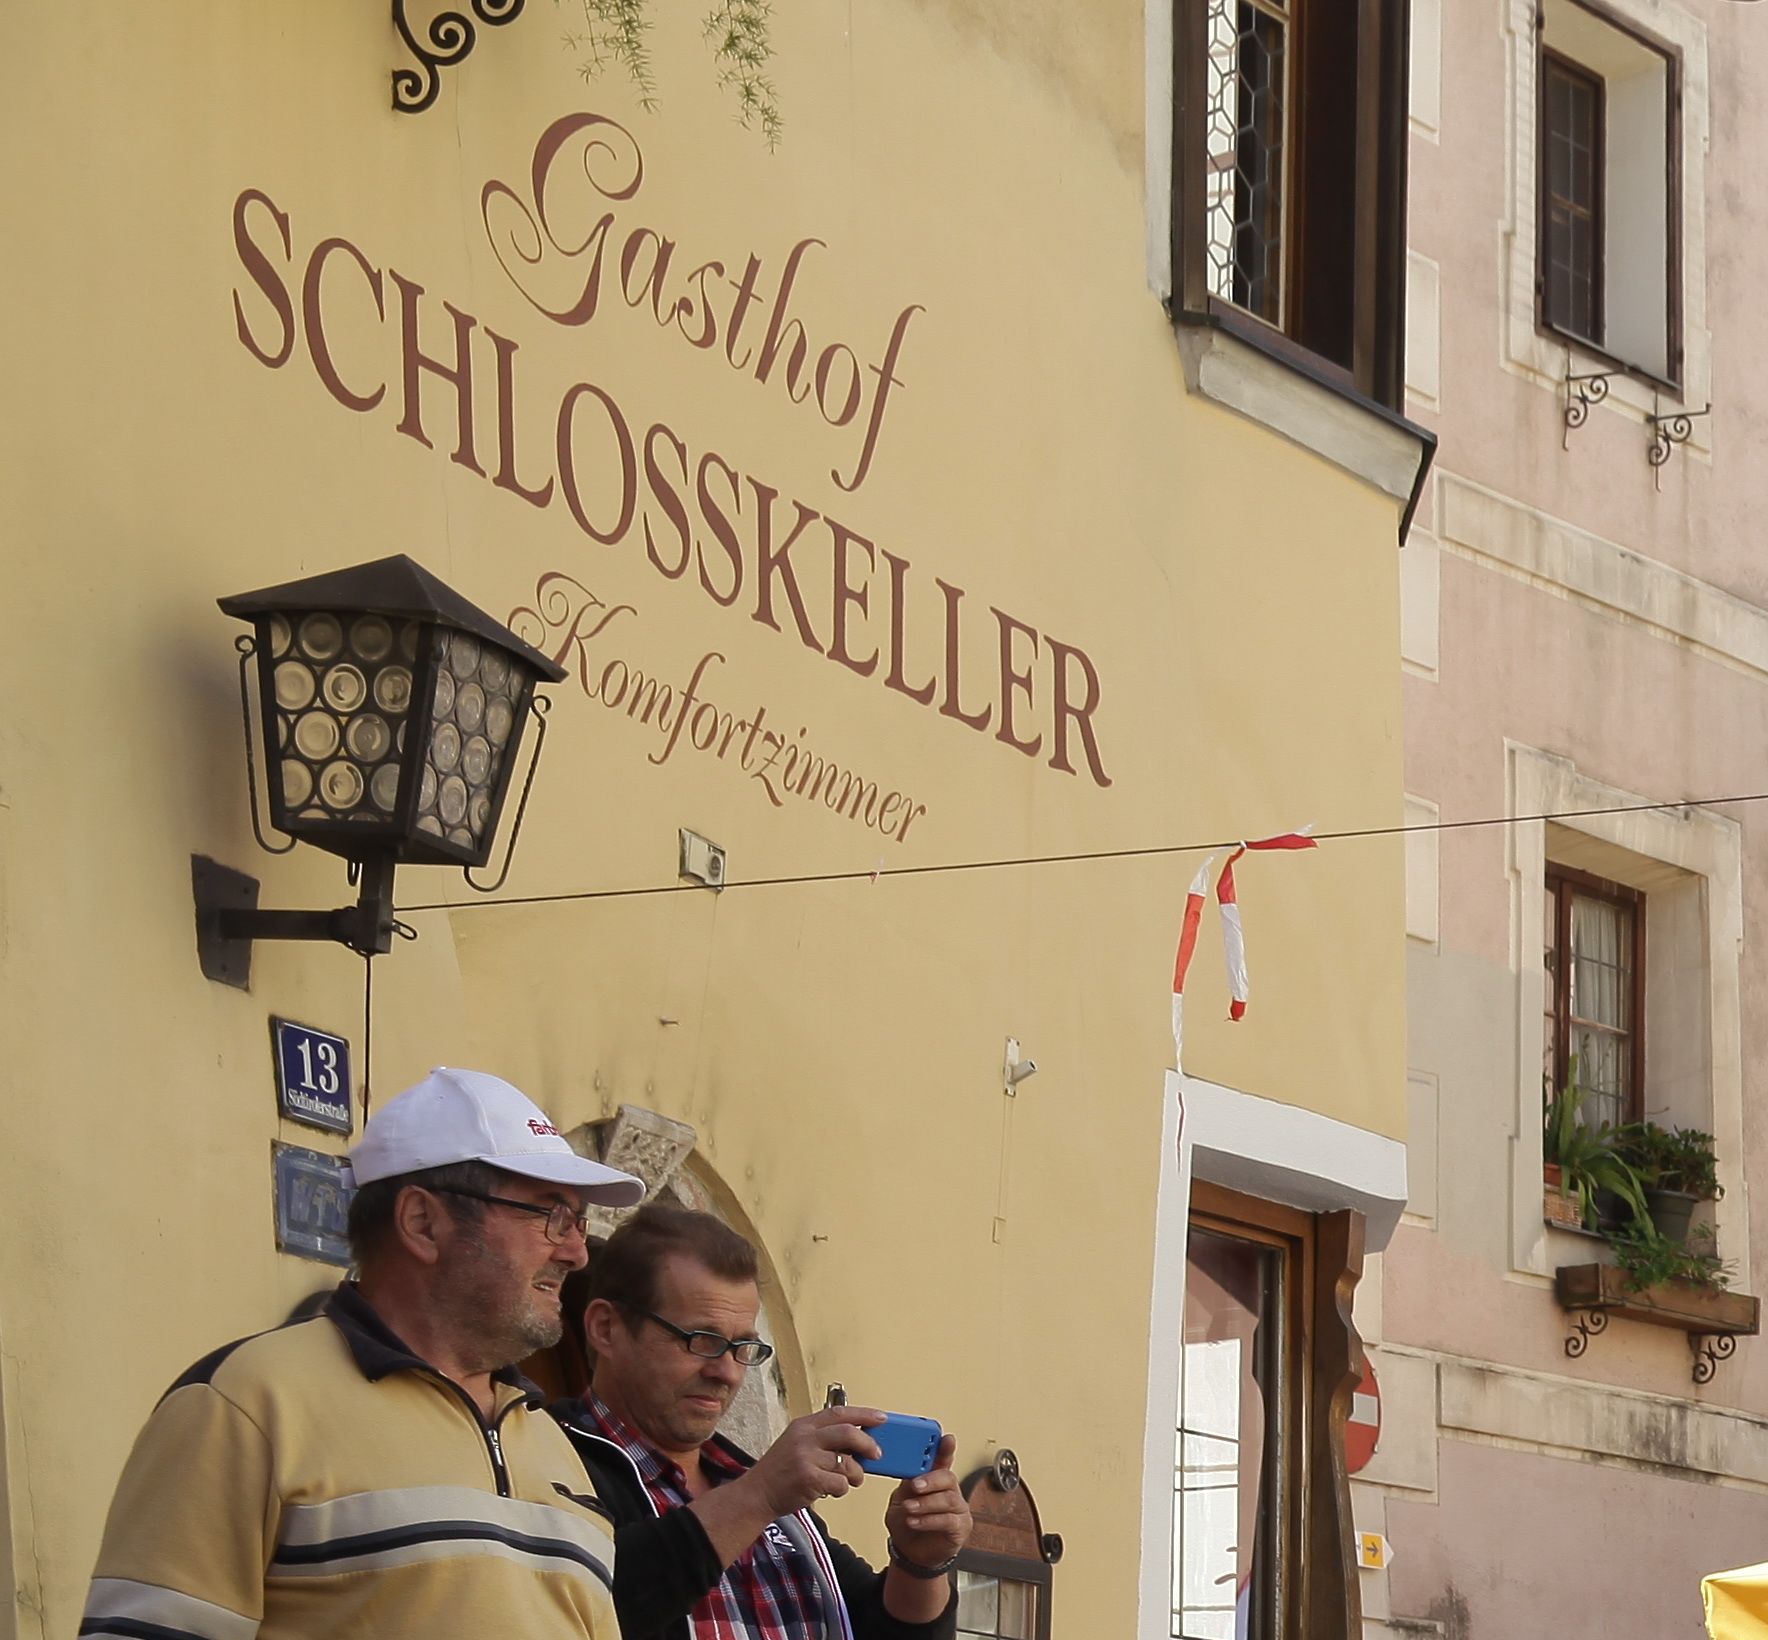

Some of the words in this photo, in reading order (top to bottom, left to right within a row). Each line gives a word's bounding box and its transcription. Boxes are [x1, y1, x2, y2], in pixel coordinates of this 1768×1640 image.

[481, 111, 926, 491] Gasthof
[232, 188, 1113, 787] SCHLOSSKELLER
[508, 571, 927, 843] Komfortzimmer
[296, 1038, 339, 1094] 13
